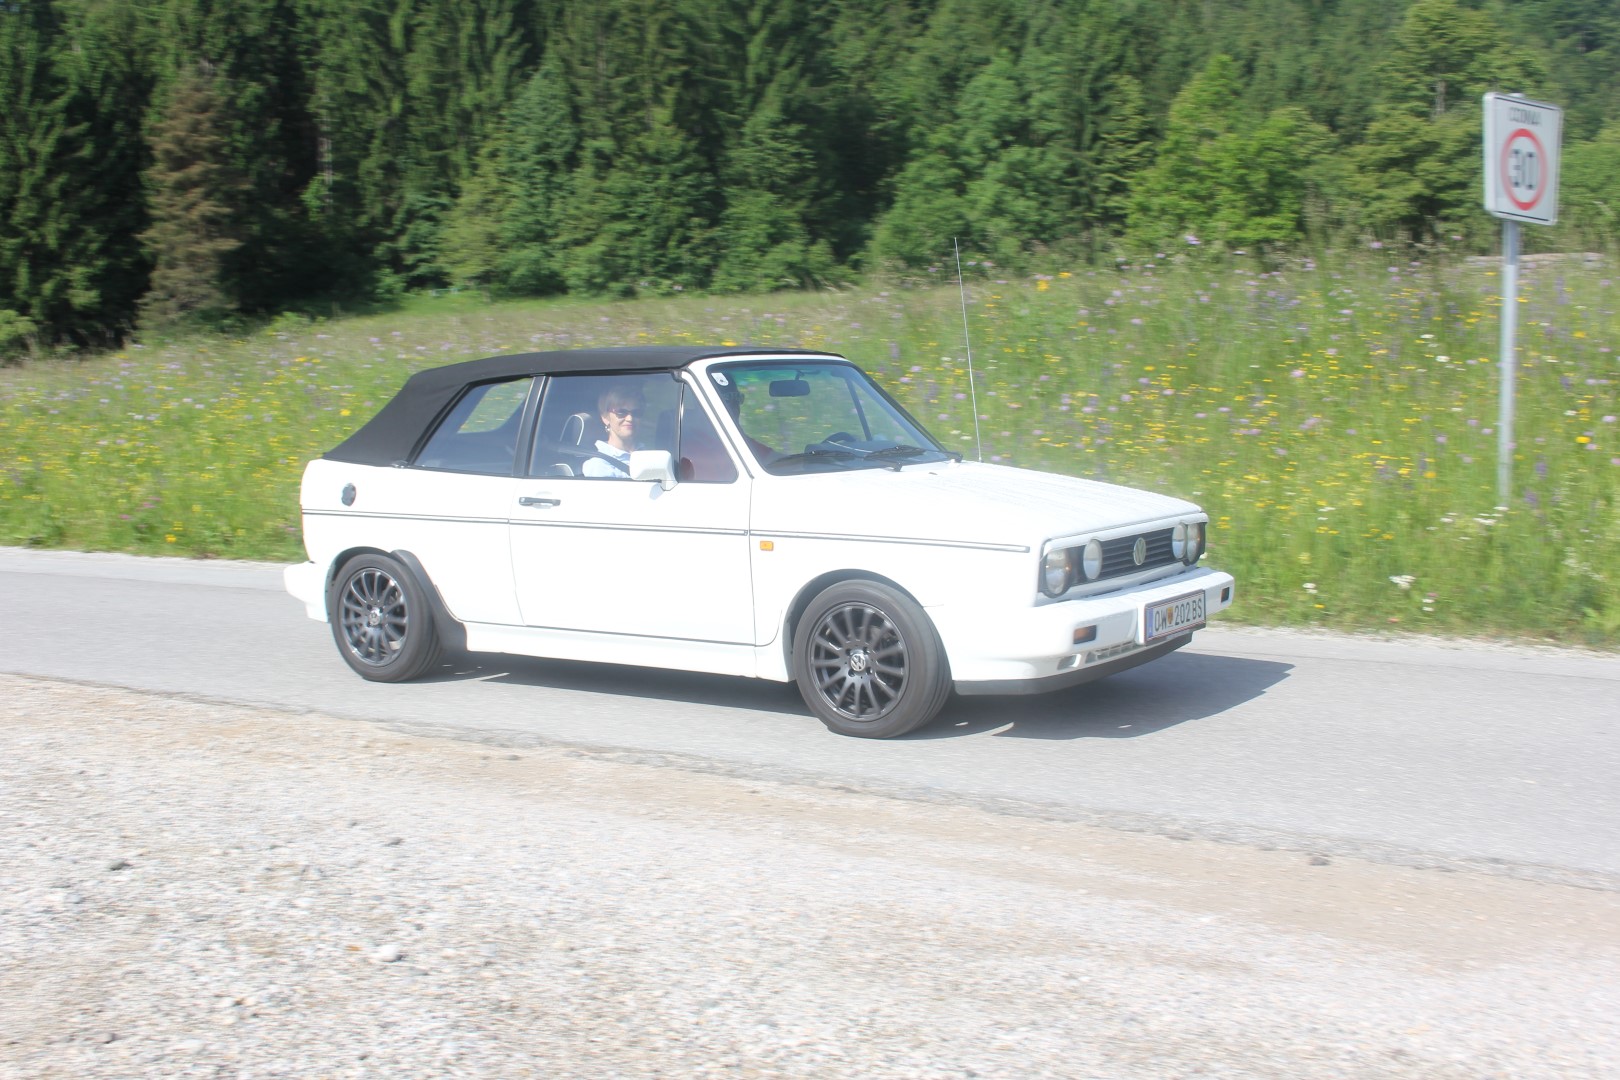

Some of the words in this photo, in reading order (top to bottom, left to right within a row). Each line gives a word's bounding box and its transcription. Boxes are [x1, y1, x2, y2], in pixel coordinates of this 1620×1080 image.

[1510, 148, 1538, 191] 30
[1174, 601, 1190, 626] 202
[1192, 598, 1203, 621] BS
